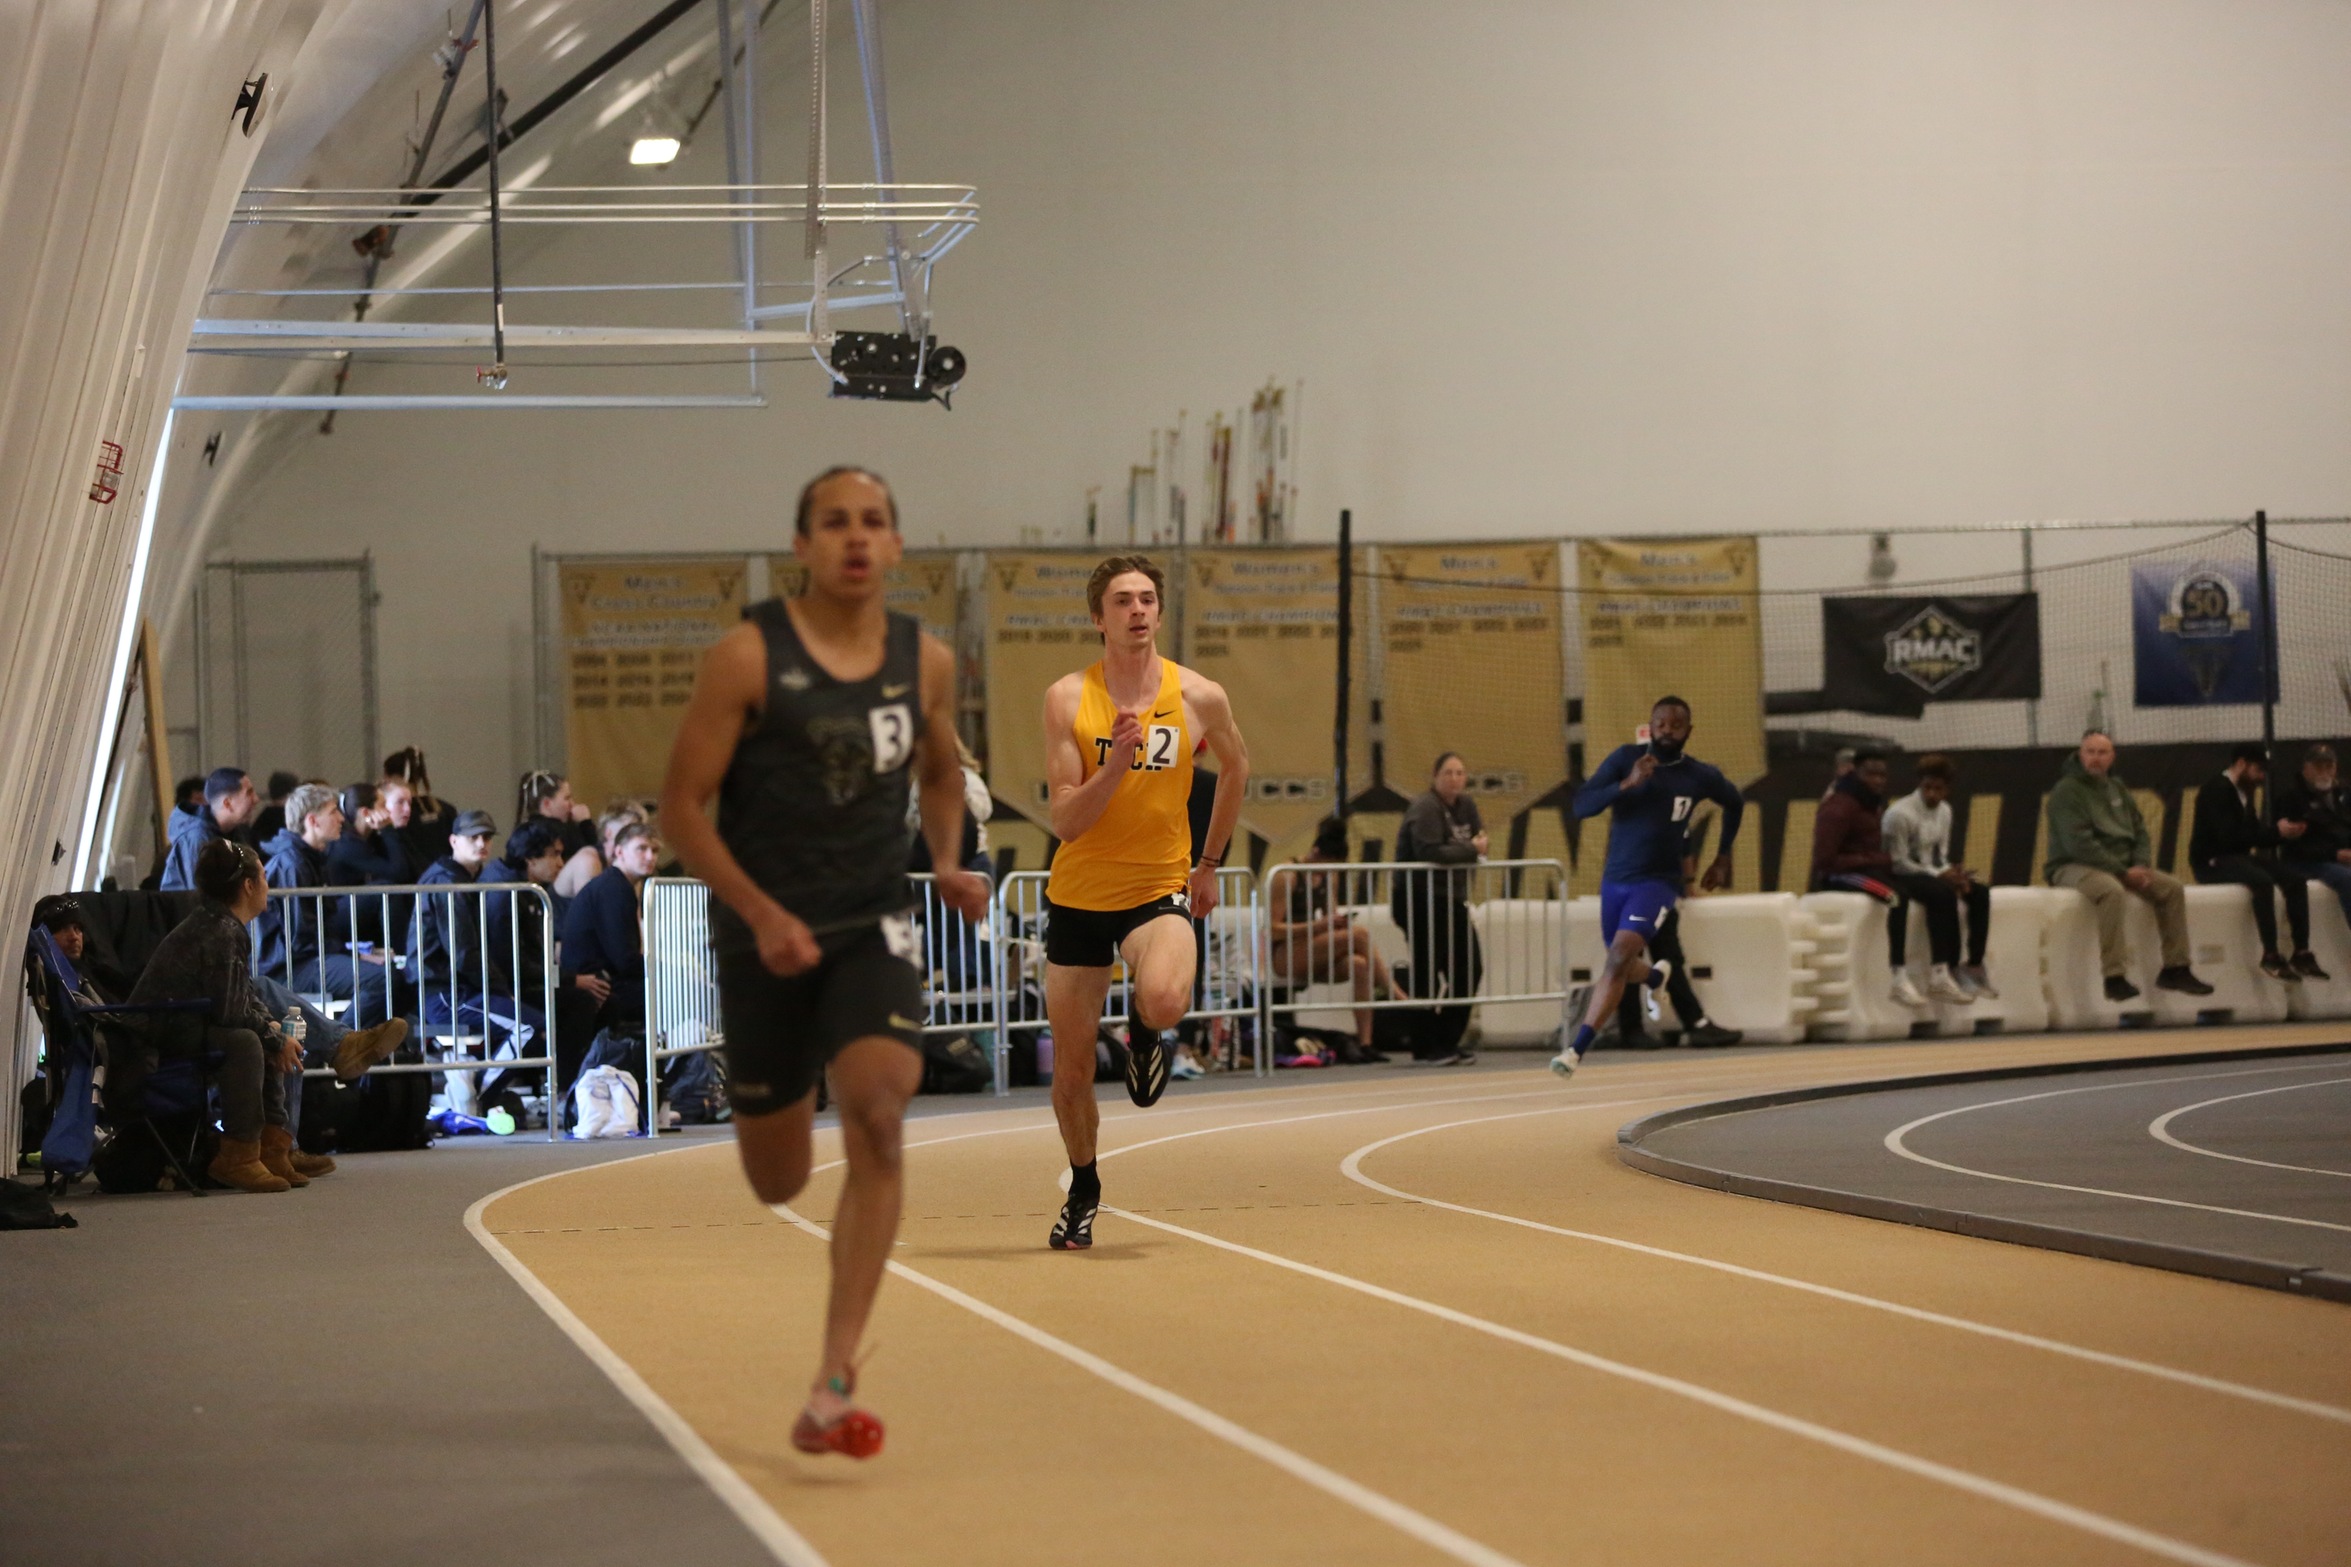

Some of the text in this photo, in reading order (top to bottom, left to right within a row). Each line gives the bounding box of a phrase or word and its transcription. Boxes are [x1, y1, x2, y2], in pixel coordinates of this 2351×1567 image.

[2185, 588, 2225, 618] 50
[1893, 634, 1975, 663] RMAC
[882, 714, 904, 763] 3
[1152, 727, 1172, 765] 2
